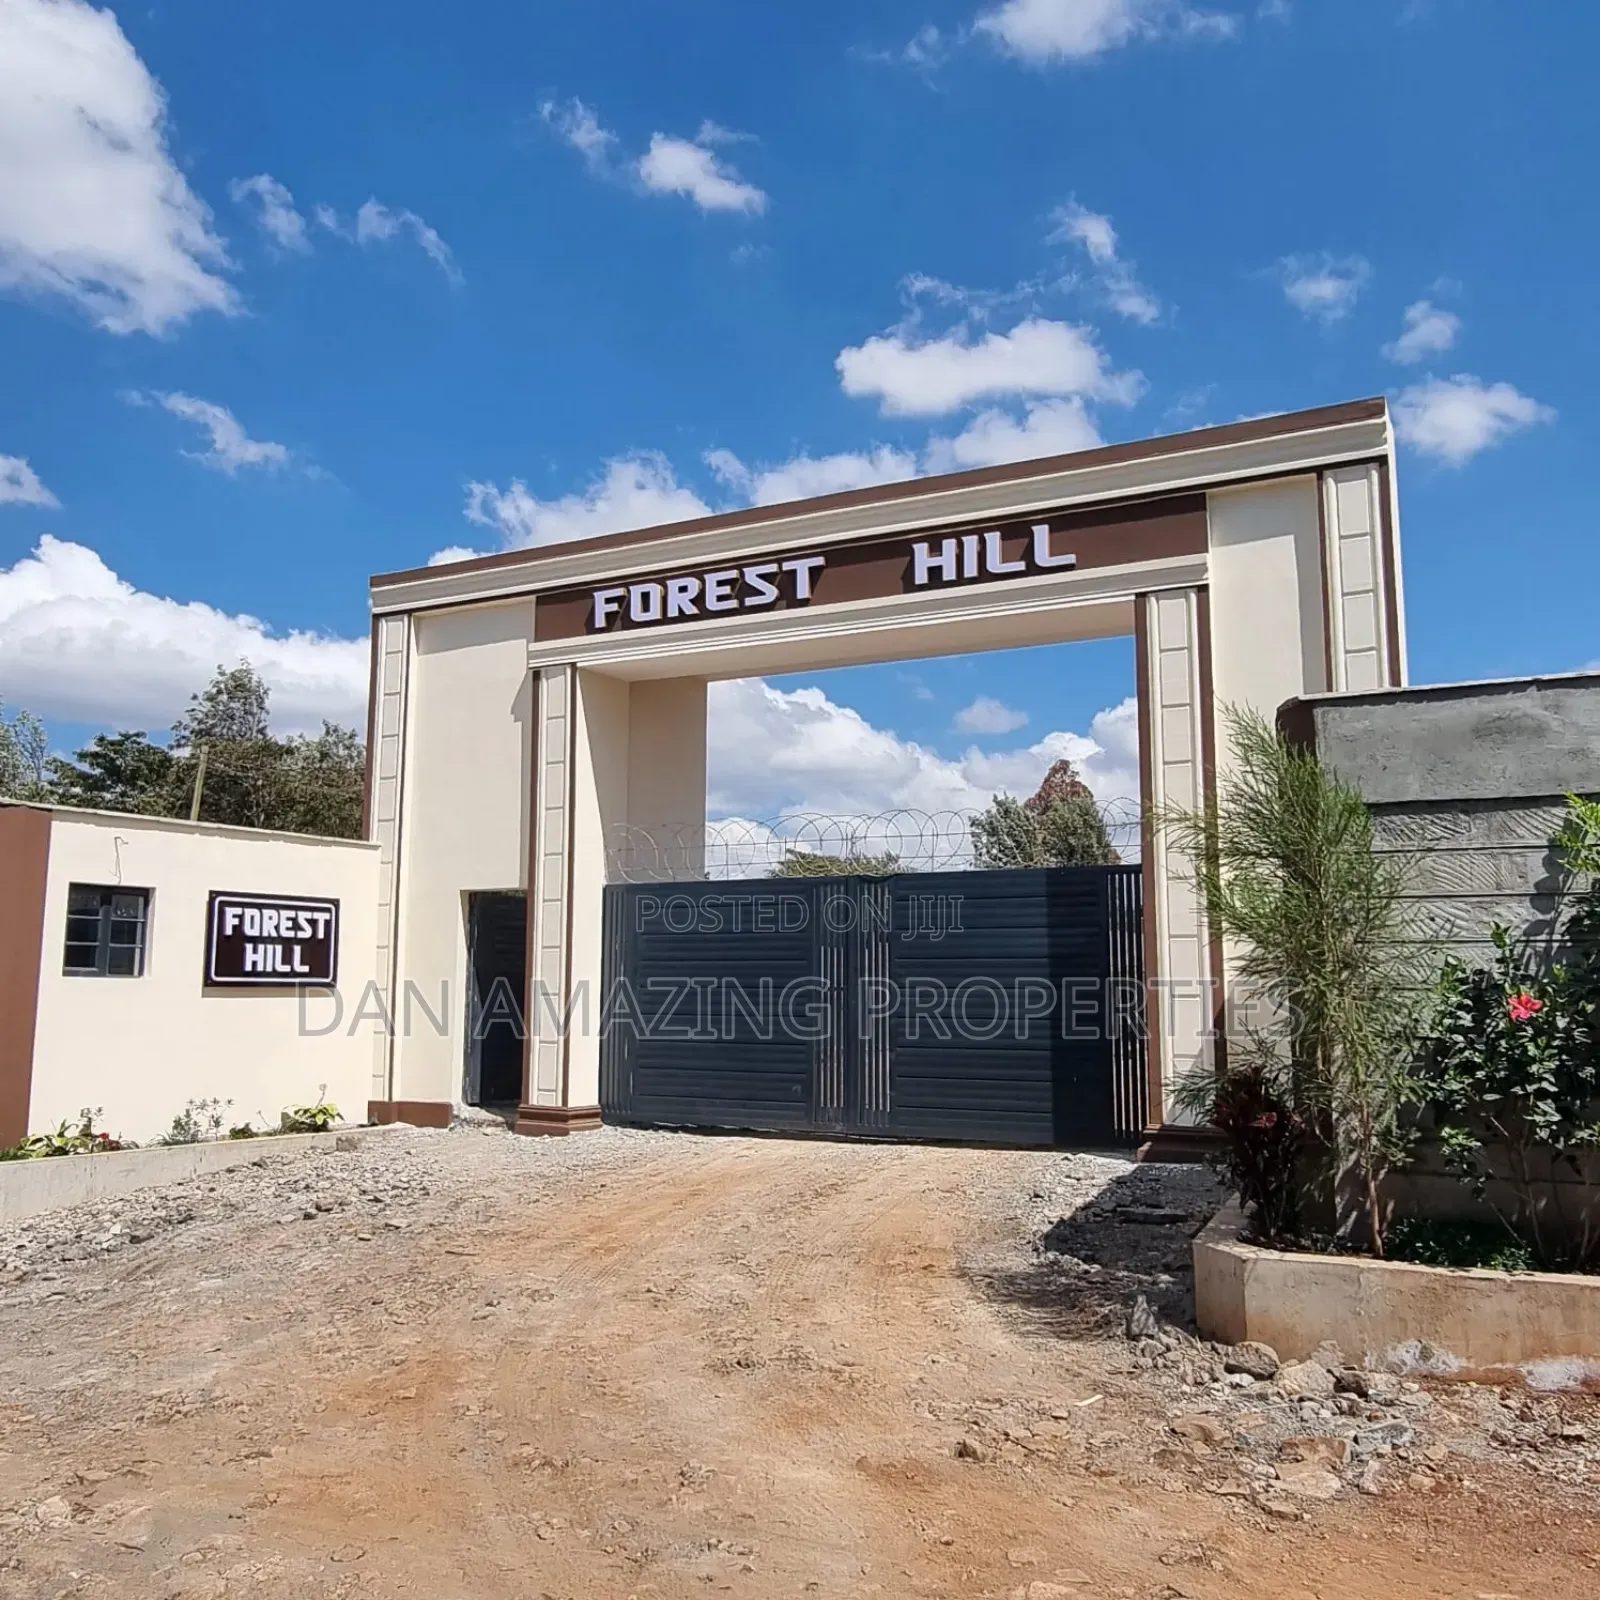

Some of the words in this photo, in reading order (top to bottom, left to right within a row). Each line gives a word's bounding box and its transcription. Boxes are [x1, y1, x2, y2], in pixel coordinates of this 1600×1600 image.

[592, 556, 826, 629] FOREST
[911, 523, 1077, 585] HILL
[223, 906, 331, 940] FOREST
[244, 943, 310, 972] HILL
